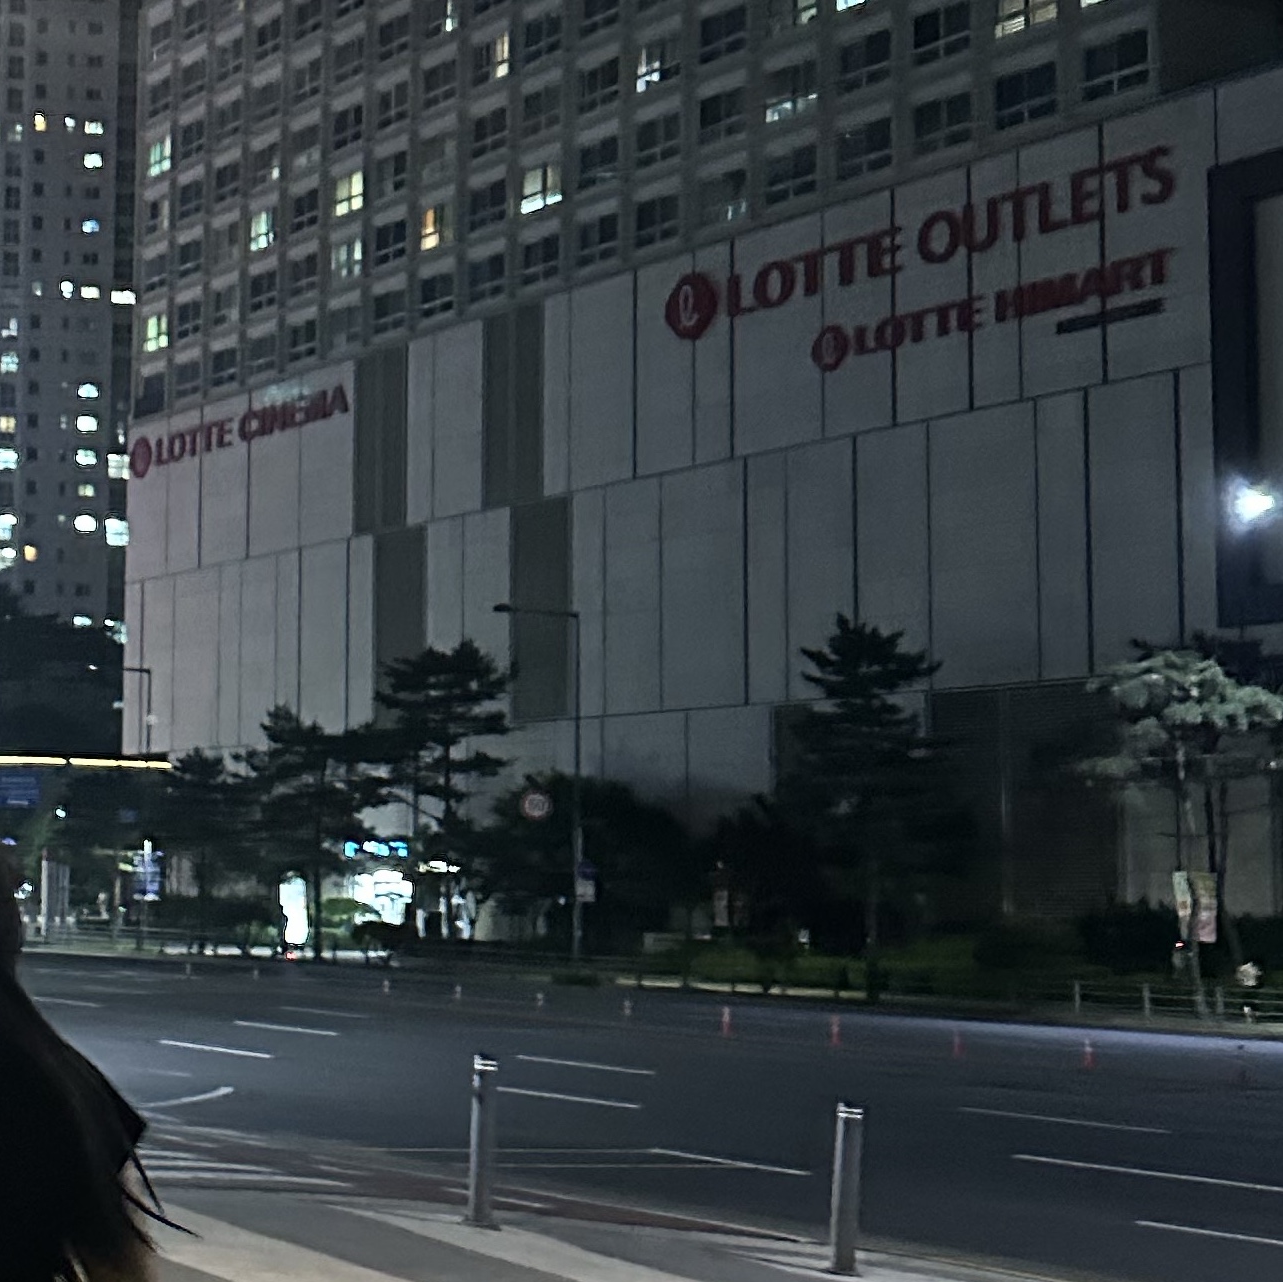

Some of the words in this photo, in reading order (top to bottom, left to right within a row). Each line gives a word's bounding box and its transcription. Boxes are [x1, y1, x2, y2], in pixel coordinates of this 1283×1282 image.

[728, 227, 903, 317] LOTTE
[918, 145, 1175, 263] OUTLETS
[856, 298, 983, 354] LOTTE
[155, 418, 233, 466] LOTTE
